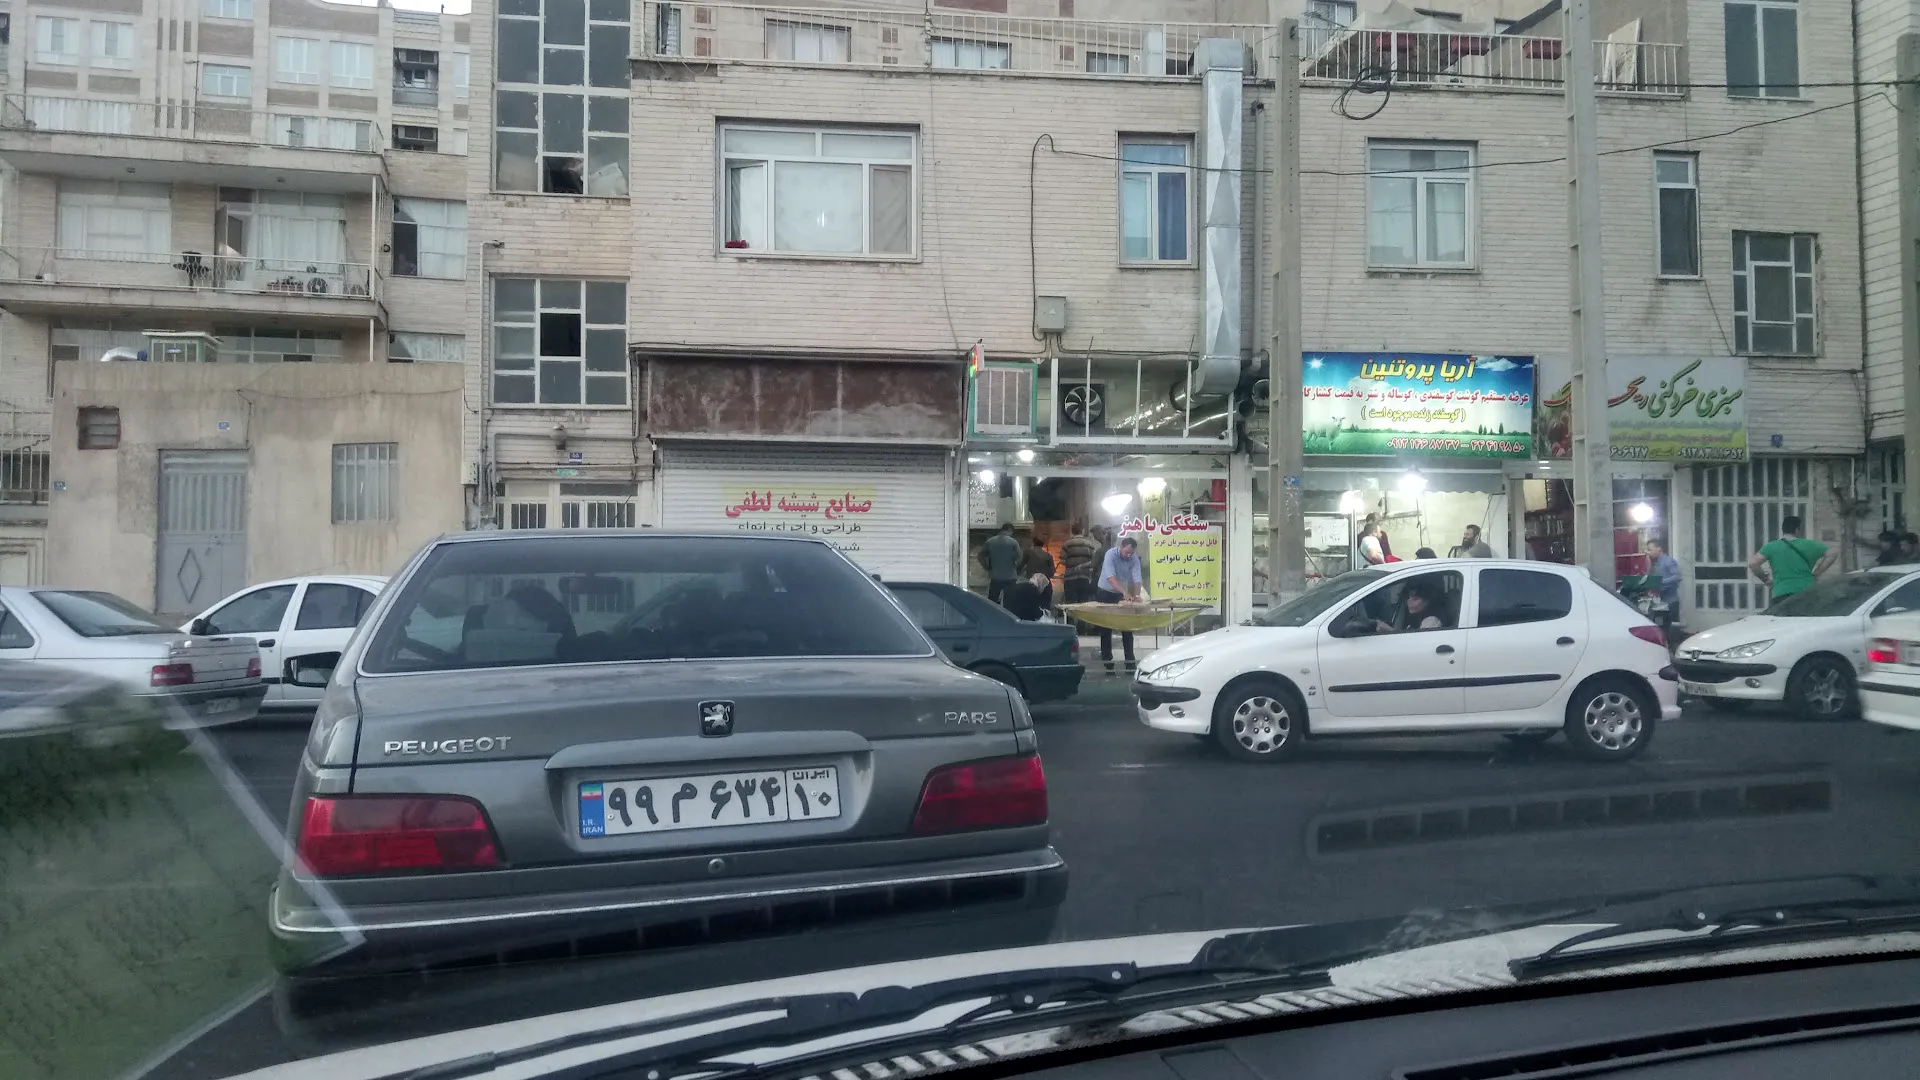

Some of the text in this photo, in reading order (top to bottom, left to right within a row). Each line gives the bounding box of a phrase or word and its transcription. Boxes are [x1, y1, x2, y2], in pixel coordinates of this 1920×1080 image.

[1360, 355, 1478, 385] آریا پروتئین
[1303, 387, 1332, 401] کشتارگا
[1335, 387, 1354, 400] قیمت
[1356, 389, 1364, 400] به
[1365, 388, 1378, 401] شتر
[1381, 392, 1385, 402] و
[1387, 387, 1413, 402] گوساله
[1456, 389, 1480, 404] گوشت
[1481, 390, 1506, 404] مستقیم
[1508, 391, 1530, 406] عرضه
[1696, 386, 1743, 419] سبزی
[1387, 408, 1412, 422] موجود
[1413, 407, 1431, 422] زنده
[725, 490, 872, 520] صنایع شیشه لطفی
[811, 523, 818, 534] و
[822, 522, 861, 534] طراحی
[1160, 514, 1209, 536] سنگکی
[832, 541, 860, 555] شیش
[1154, 538, 1218, 547] قابل توجه مشتریان عزیز
[1156, 554, 1215, 563] ساعت کار نانوایی
[1192, 568, 1199, 577] از
[1168, 581, 1180, 590] الی
[1182, 582, 1196, 590] صبح
[944, 711, 998, 725] PARS
[384, 736, 512, 756] PEUGEOT
[792, 769, 830, 781] ایران
[794, 783, 833, 817] ۱۰
[582, 818, 597, 826] I.R.
[582, 826, 604, 834] IRAN
